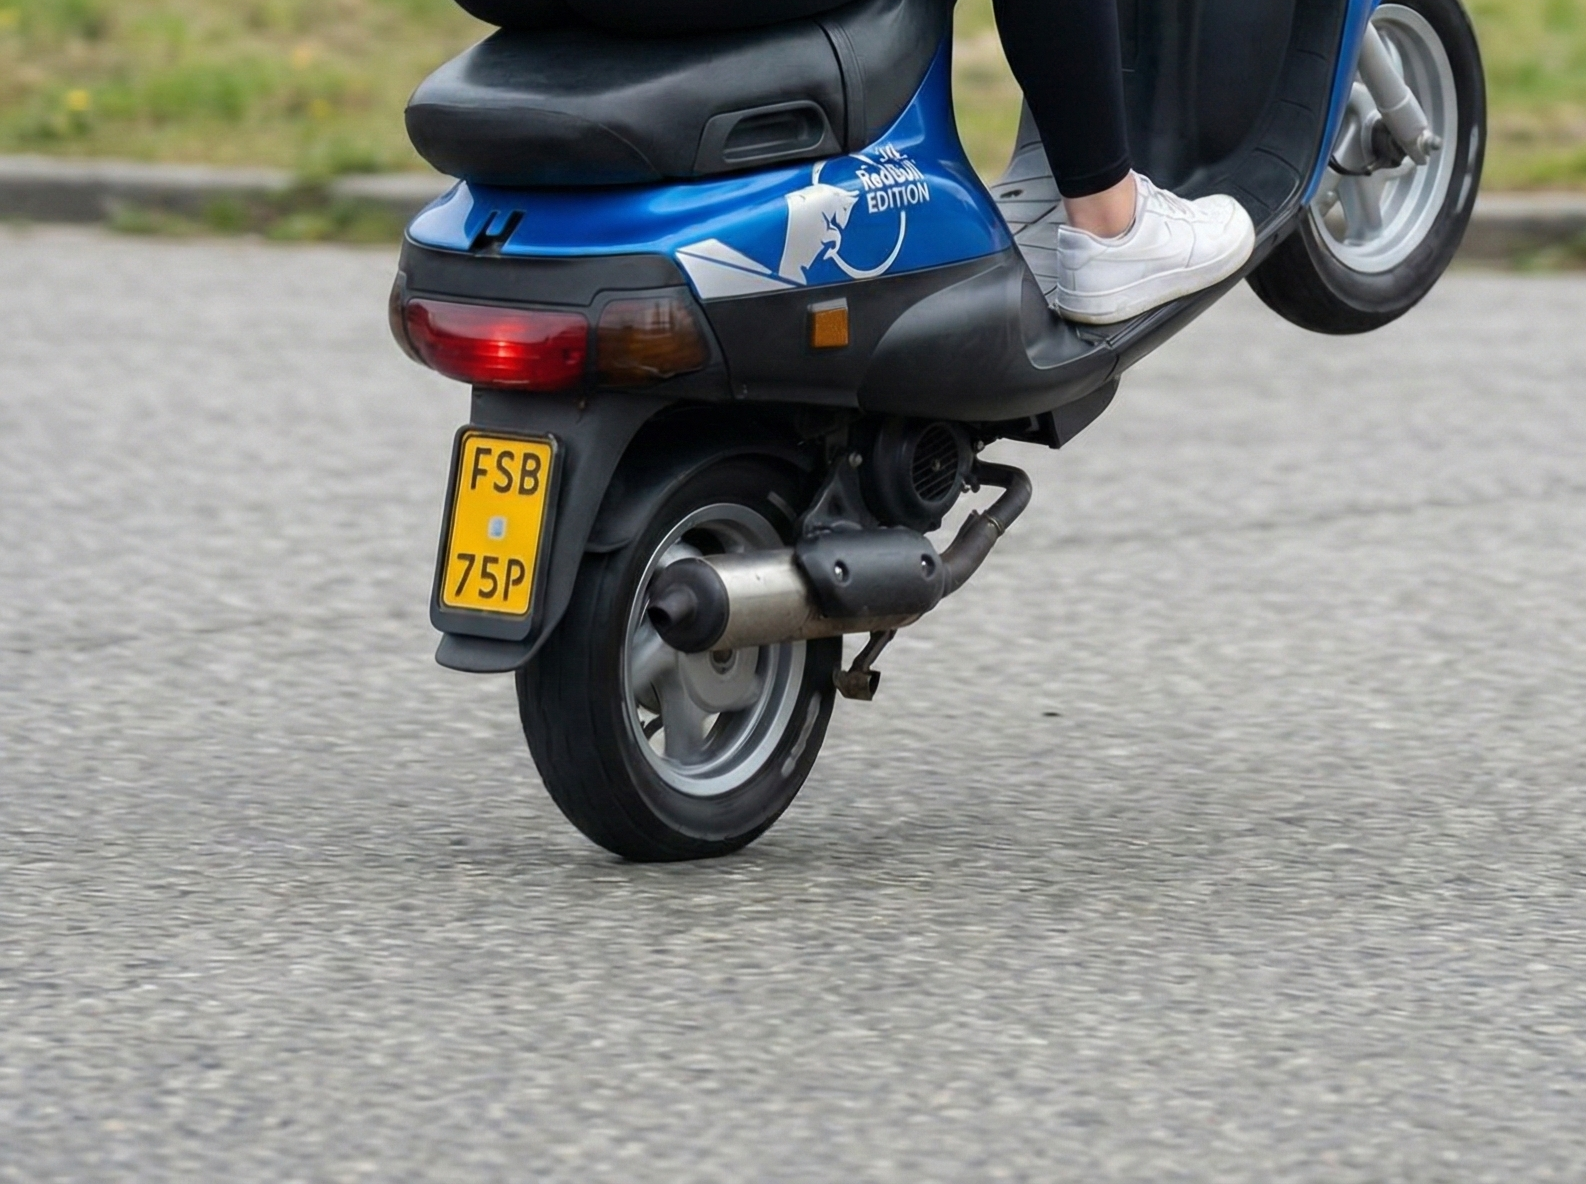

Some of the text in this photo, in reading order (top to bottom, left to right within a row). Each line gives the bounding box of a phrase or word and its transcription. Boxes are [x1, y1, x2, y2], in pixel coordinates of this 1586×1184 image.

[866, 181, 930, 214] EDITION
[470, 446, 542, 496] FSB
[454, 552, 526, 602] 75P
